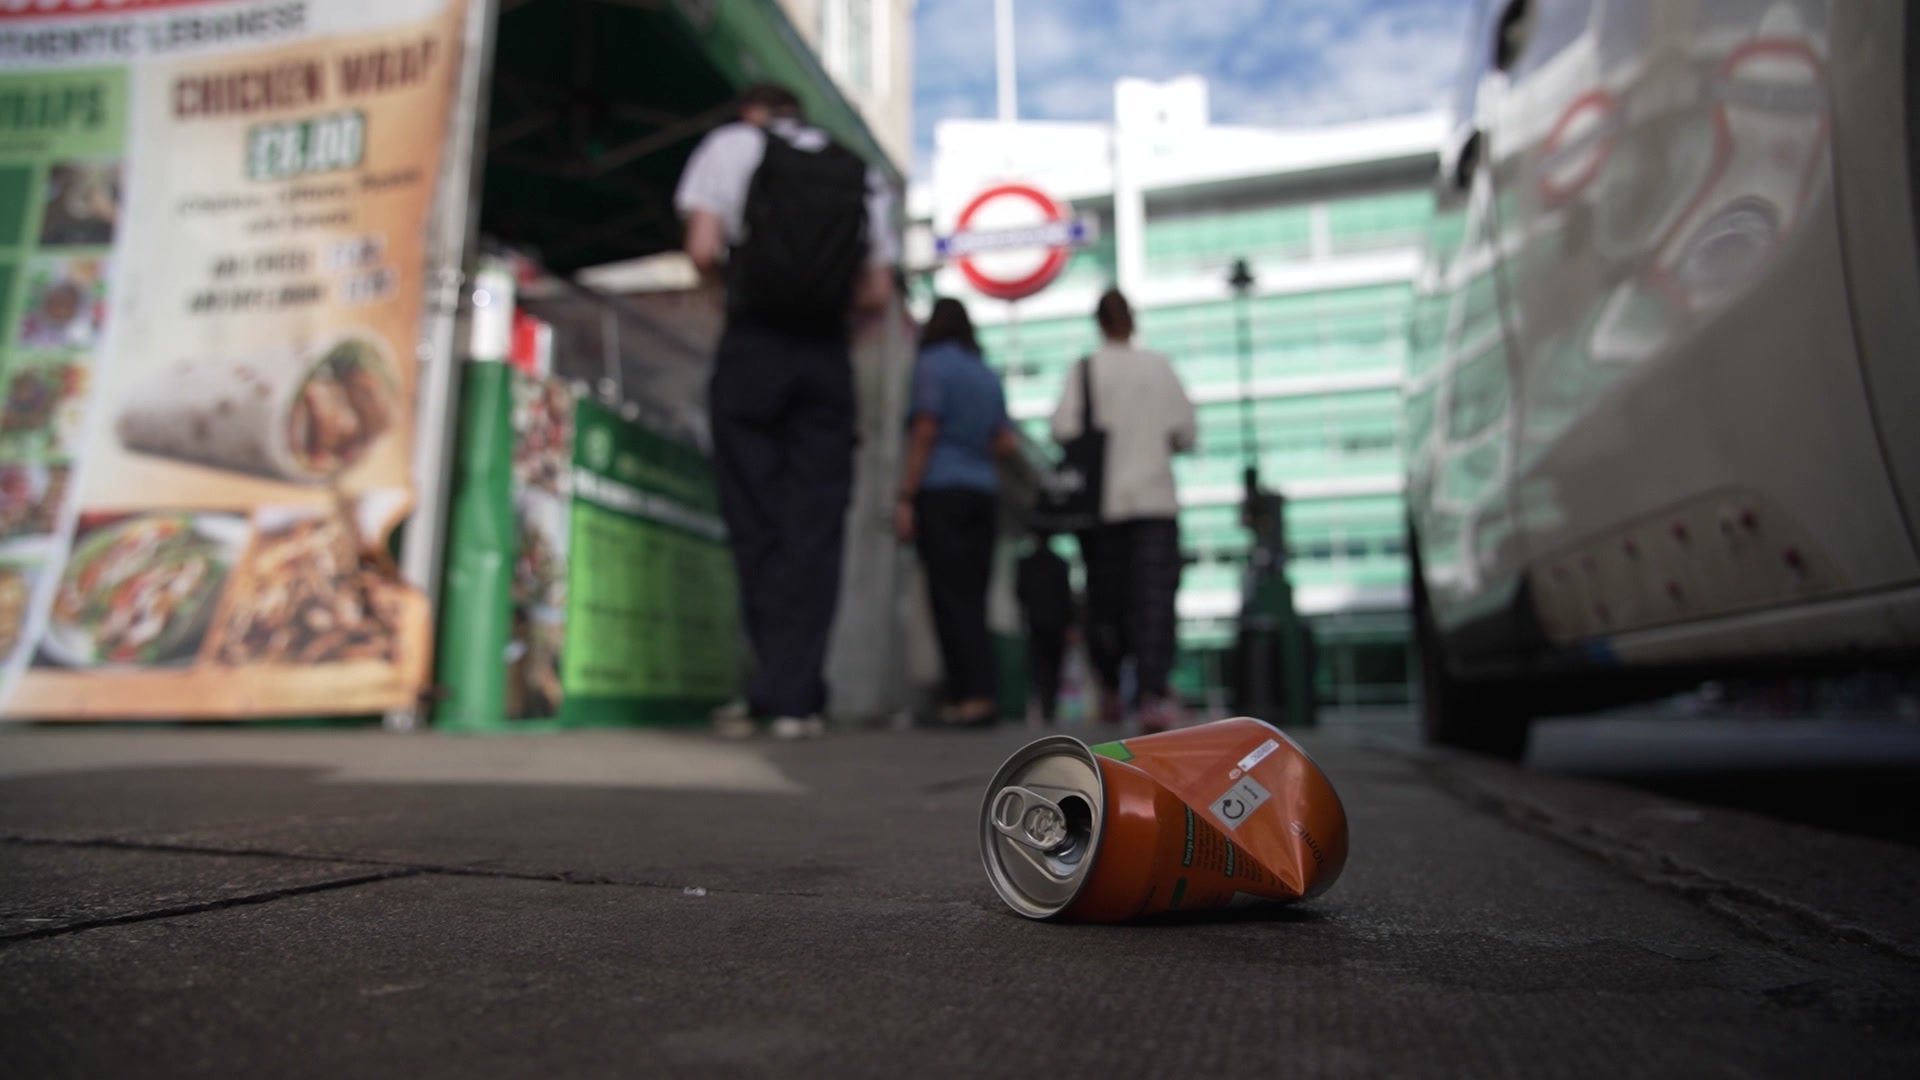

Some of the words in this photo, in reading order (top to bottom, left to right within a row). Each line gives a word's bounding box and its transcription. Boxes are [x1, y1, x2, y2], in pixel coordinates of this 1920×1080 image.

[150, 3, 307, 52] LEBANESE
[172, 60, 325, 120] CHICKEN
[339, 37, 436, 97] WRAP
[1183, 841, 1194, 865] Storage
